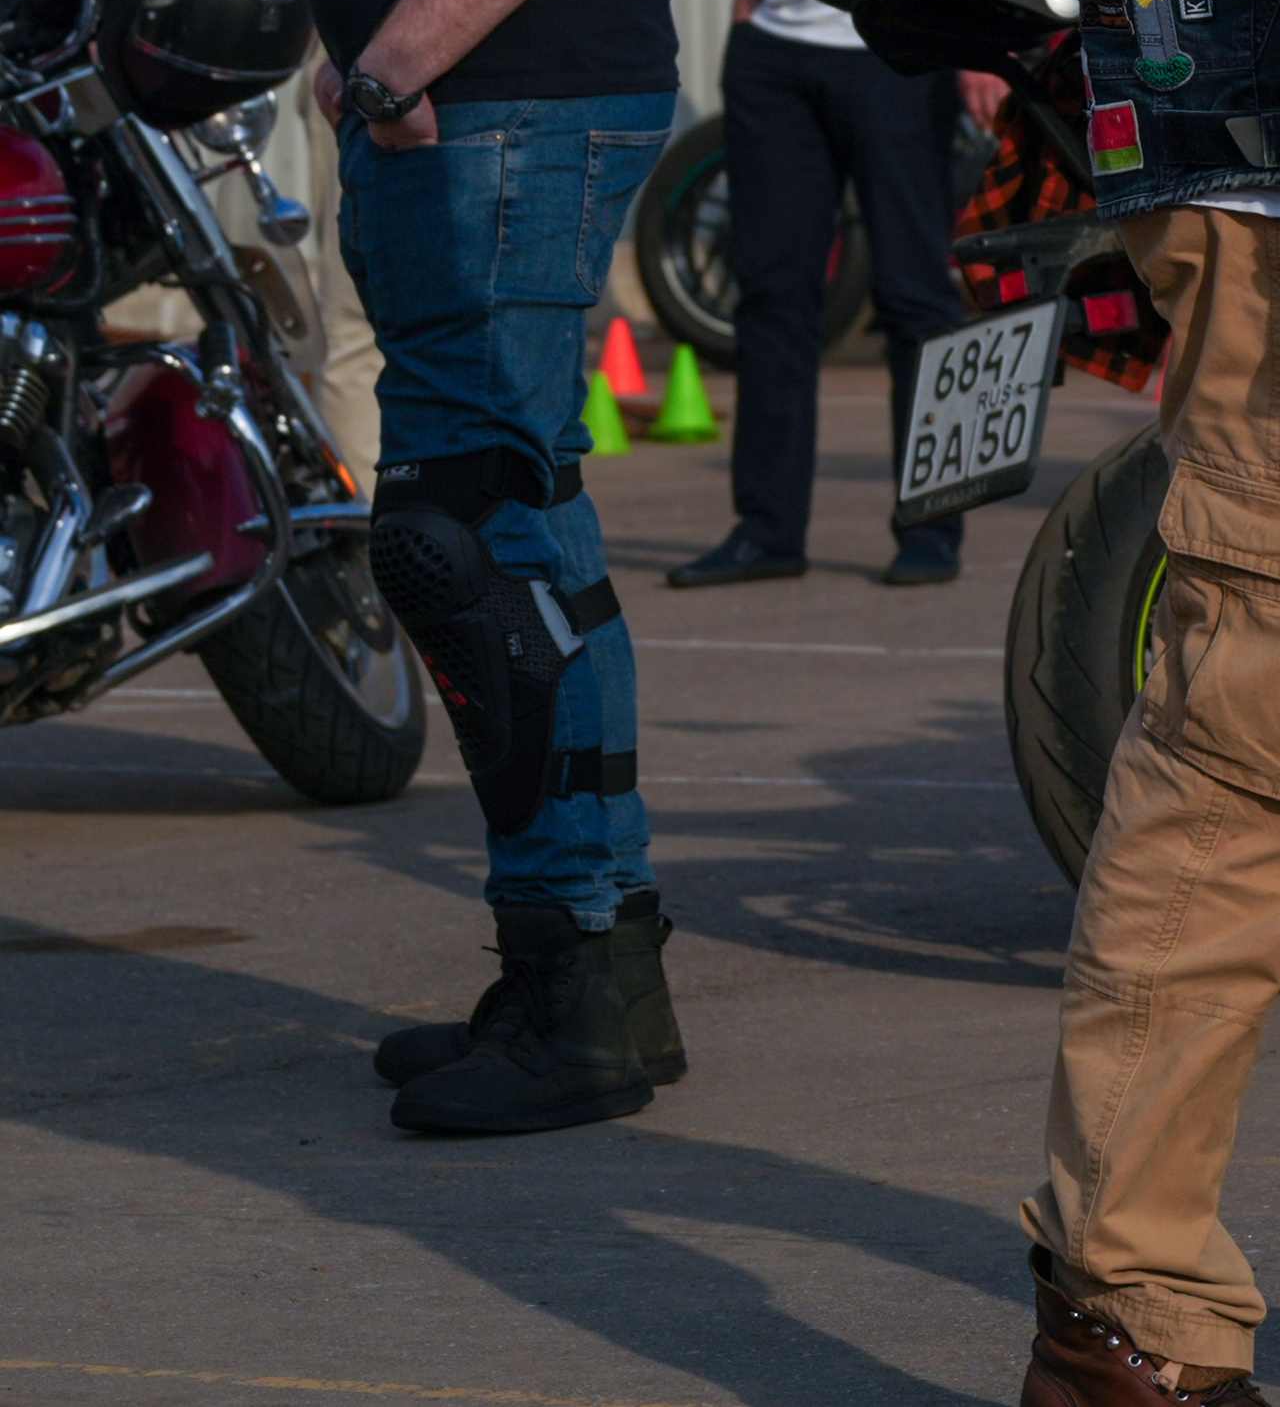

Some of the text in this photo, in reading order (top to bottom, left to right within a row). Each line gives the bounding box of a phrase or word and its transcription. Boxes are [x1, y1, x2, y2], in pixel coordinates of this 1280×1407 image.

[935, 322, 1034, 402] 6847
[978, 383, 1013, 412] RUS
[979, 403, 1026, 465] 50
